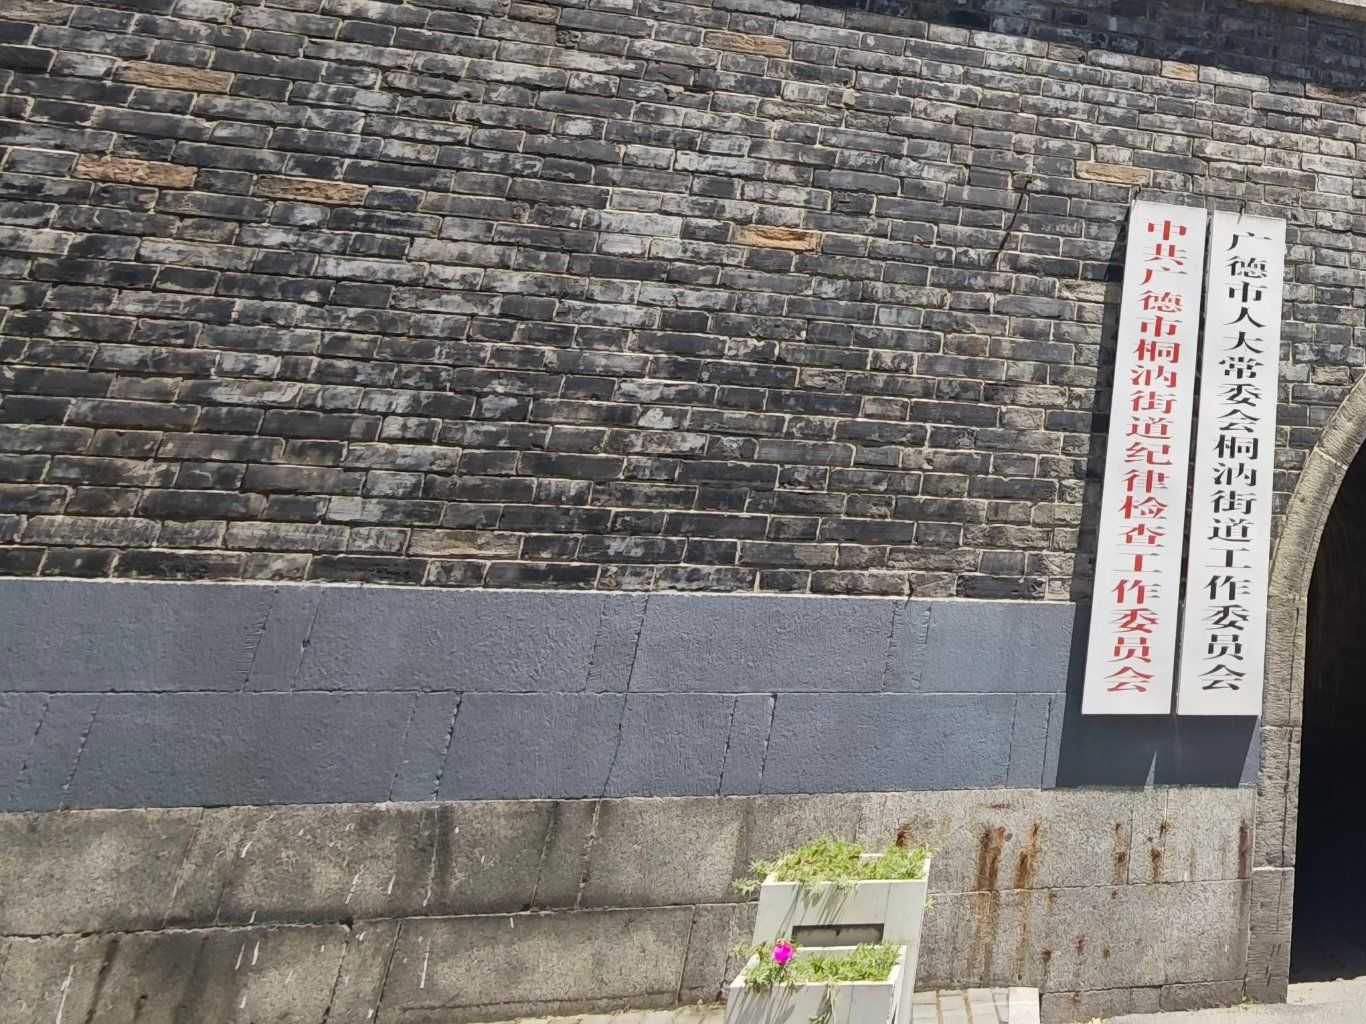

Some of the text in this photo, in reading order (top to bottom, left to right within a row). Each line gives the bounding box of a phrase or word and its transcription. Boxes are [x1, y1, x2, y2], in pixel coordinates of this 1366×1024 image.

[1104, 219, 1187, 693] 中共广德市桐汭街道纪律检查工作委员会
[1201, 231, 1271, 692] 广德市人大常委会桐汭街道工作委员会
